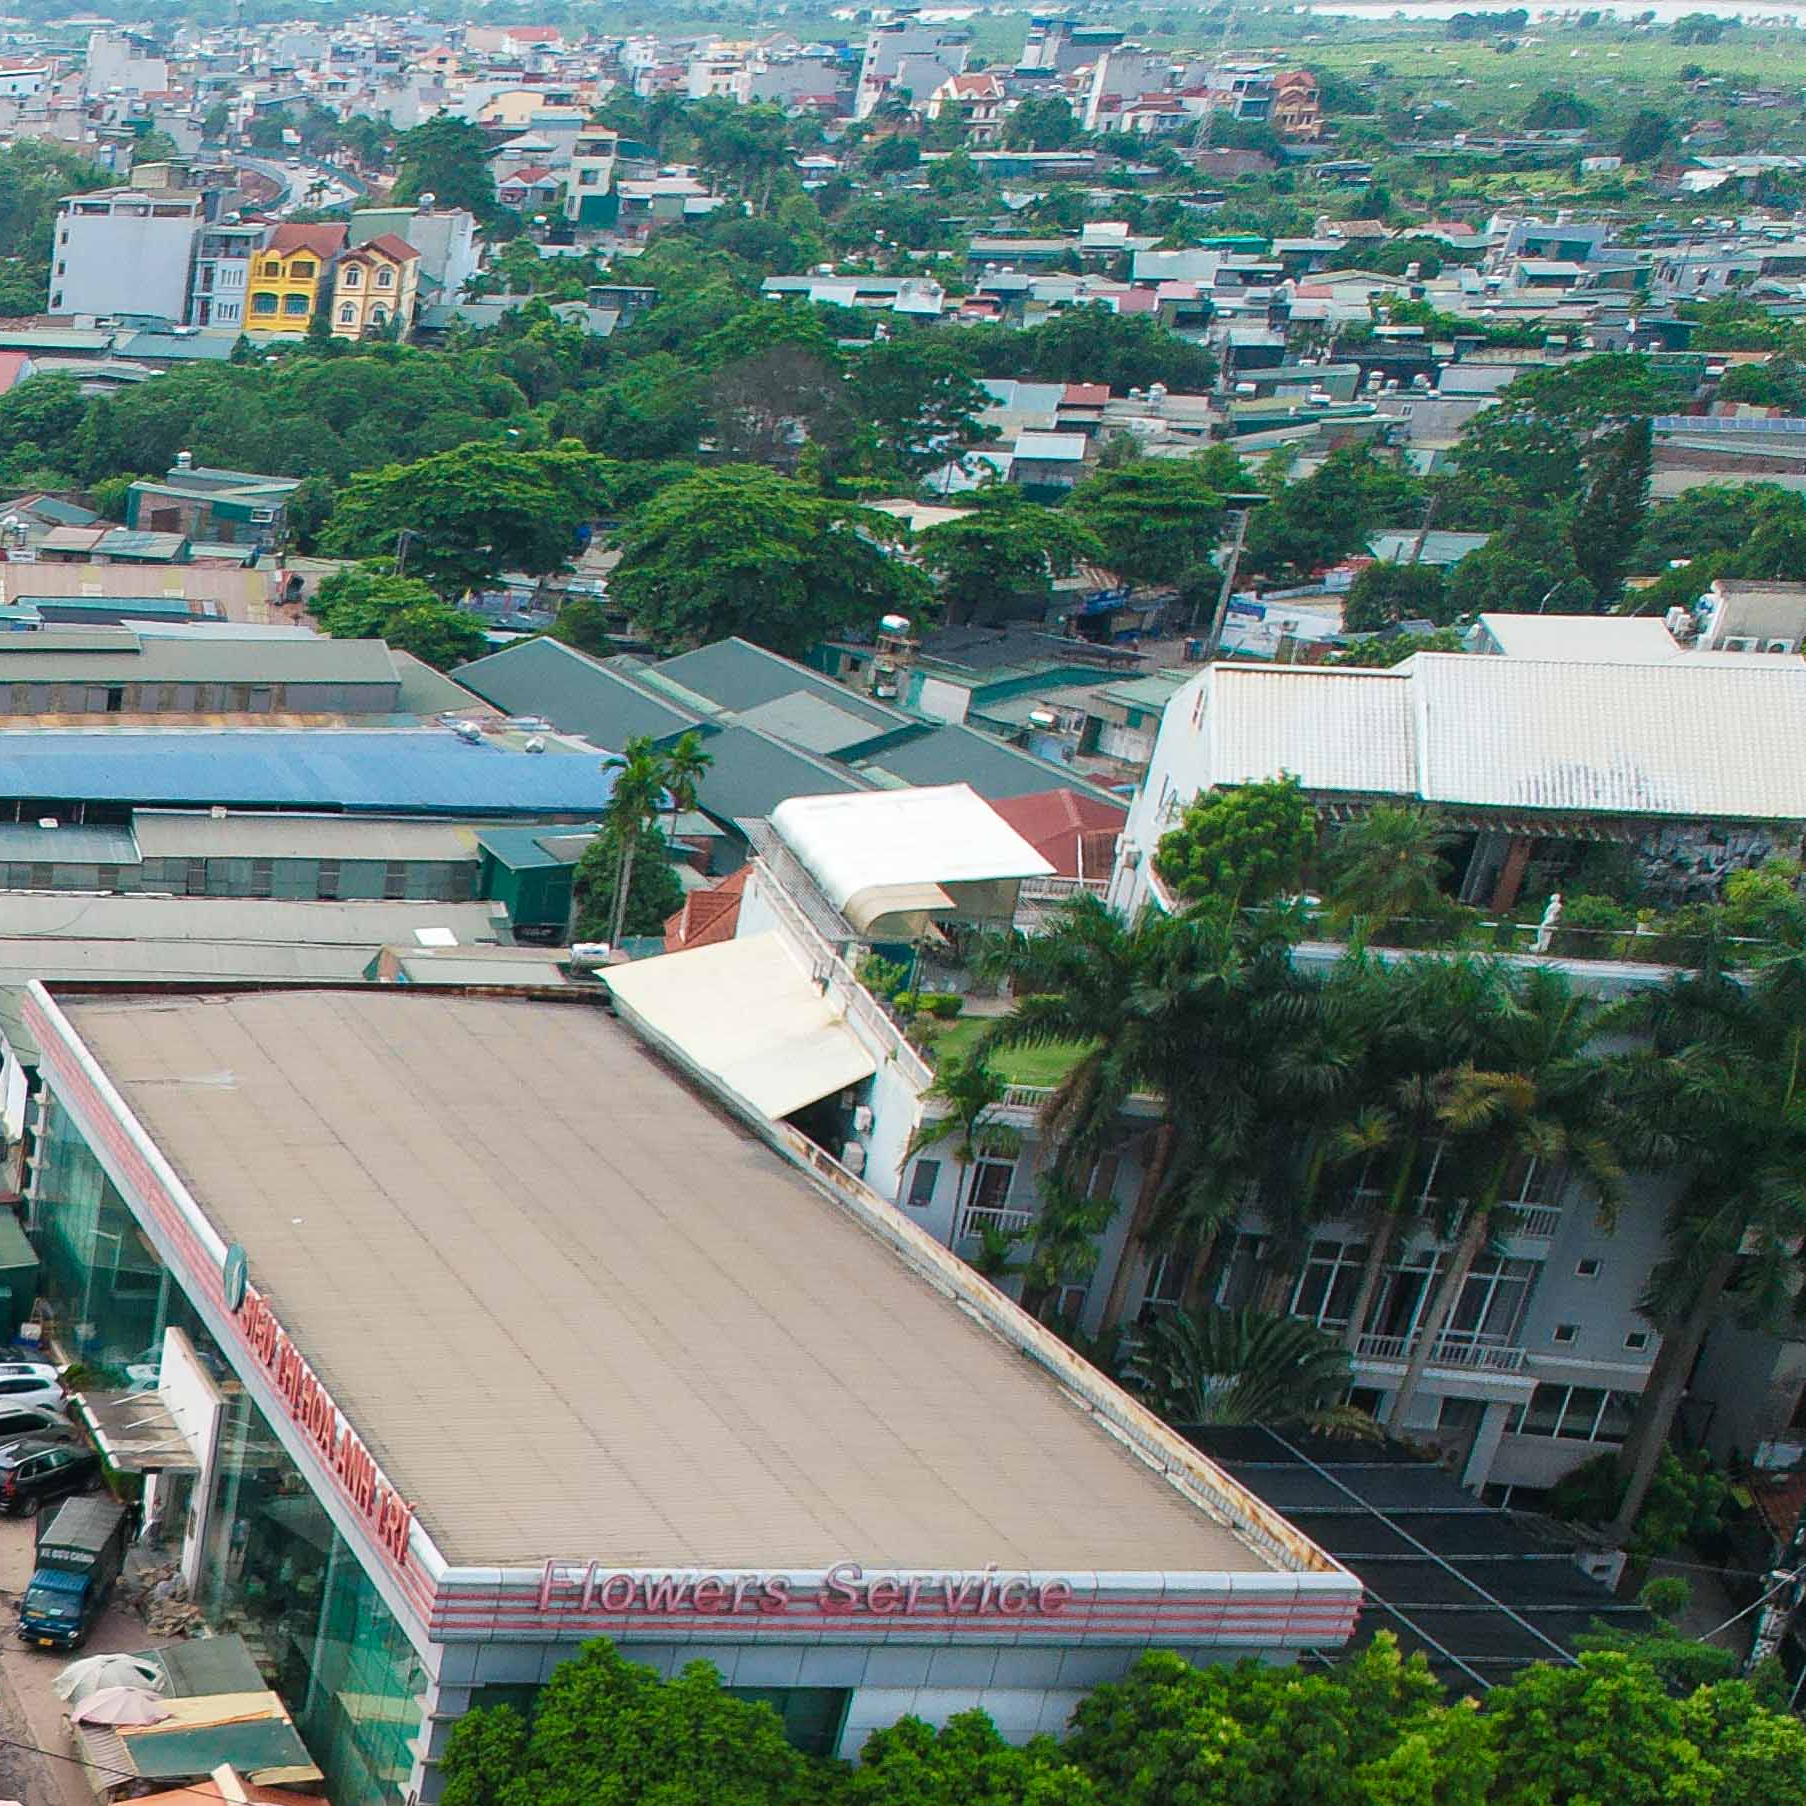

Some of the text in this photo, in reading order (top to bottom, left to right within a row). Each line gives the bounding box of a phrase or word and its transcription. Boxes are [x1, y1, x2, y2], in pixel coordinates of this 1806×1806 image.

[301, 1370, 337, 1462] HOA
[539, 1559, 1074, 1615] Flowers Service
